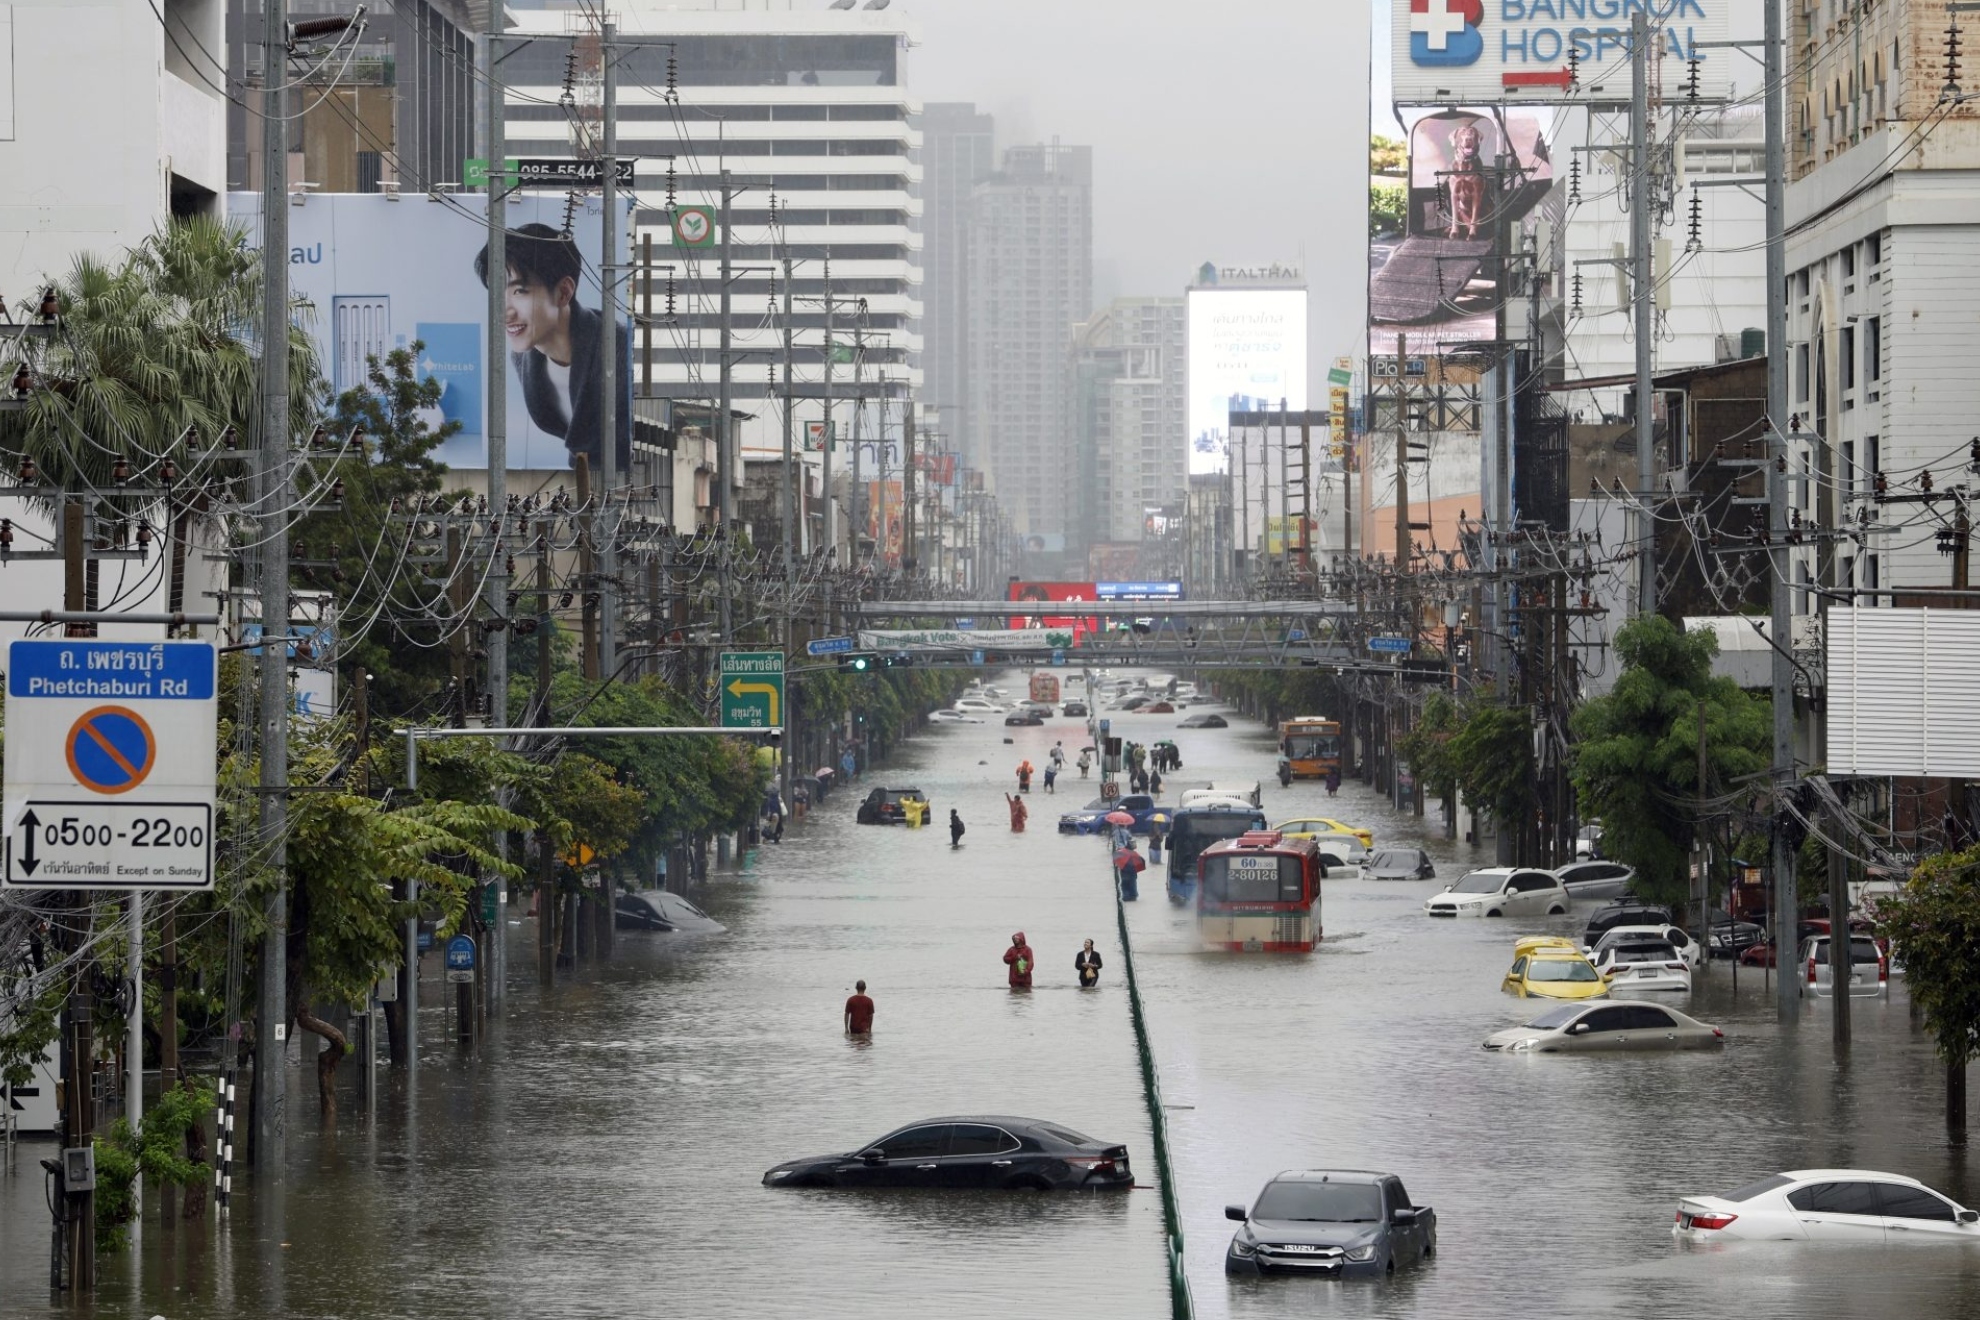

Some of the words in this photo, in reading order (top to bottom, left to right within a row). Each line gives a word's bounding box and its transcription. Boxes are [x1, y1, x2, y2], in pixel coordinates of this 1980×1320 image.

[1222, 268, 1298, 278] ITALTHAI
[877, 632, 927, 648] Bangkok
[930, 631, 957, 643] Vote
[60, 650, 80, 669] ถ.
[87, 644, 164, 678] เพชรบุรี
[723, 655, 782, 671] เส้นทางลัด
[29, 677, 150, 696] Phetchaburi
[160, 679, 188, 696] Rd
[731, 705, 762, 720] สุขุมวิท
[750, 719, 762, 727] 55
[1241, 858, 1257, 868] 60
[117, 865, 149, 876] Except
[152, 868, 165, 876] on
[168, 866, 203, 877] Sunday
[1228, 869, 1278, 881] 2-80126
